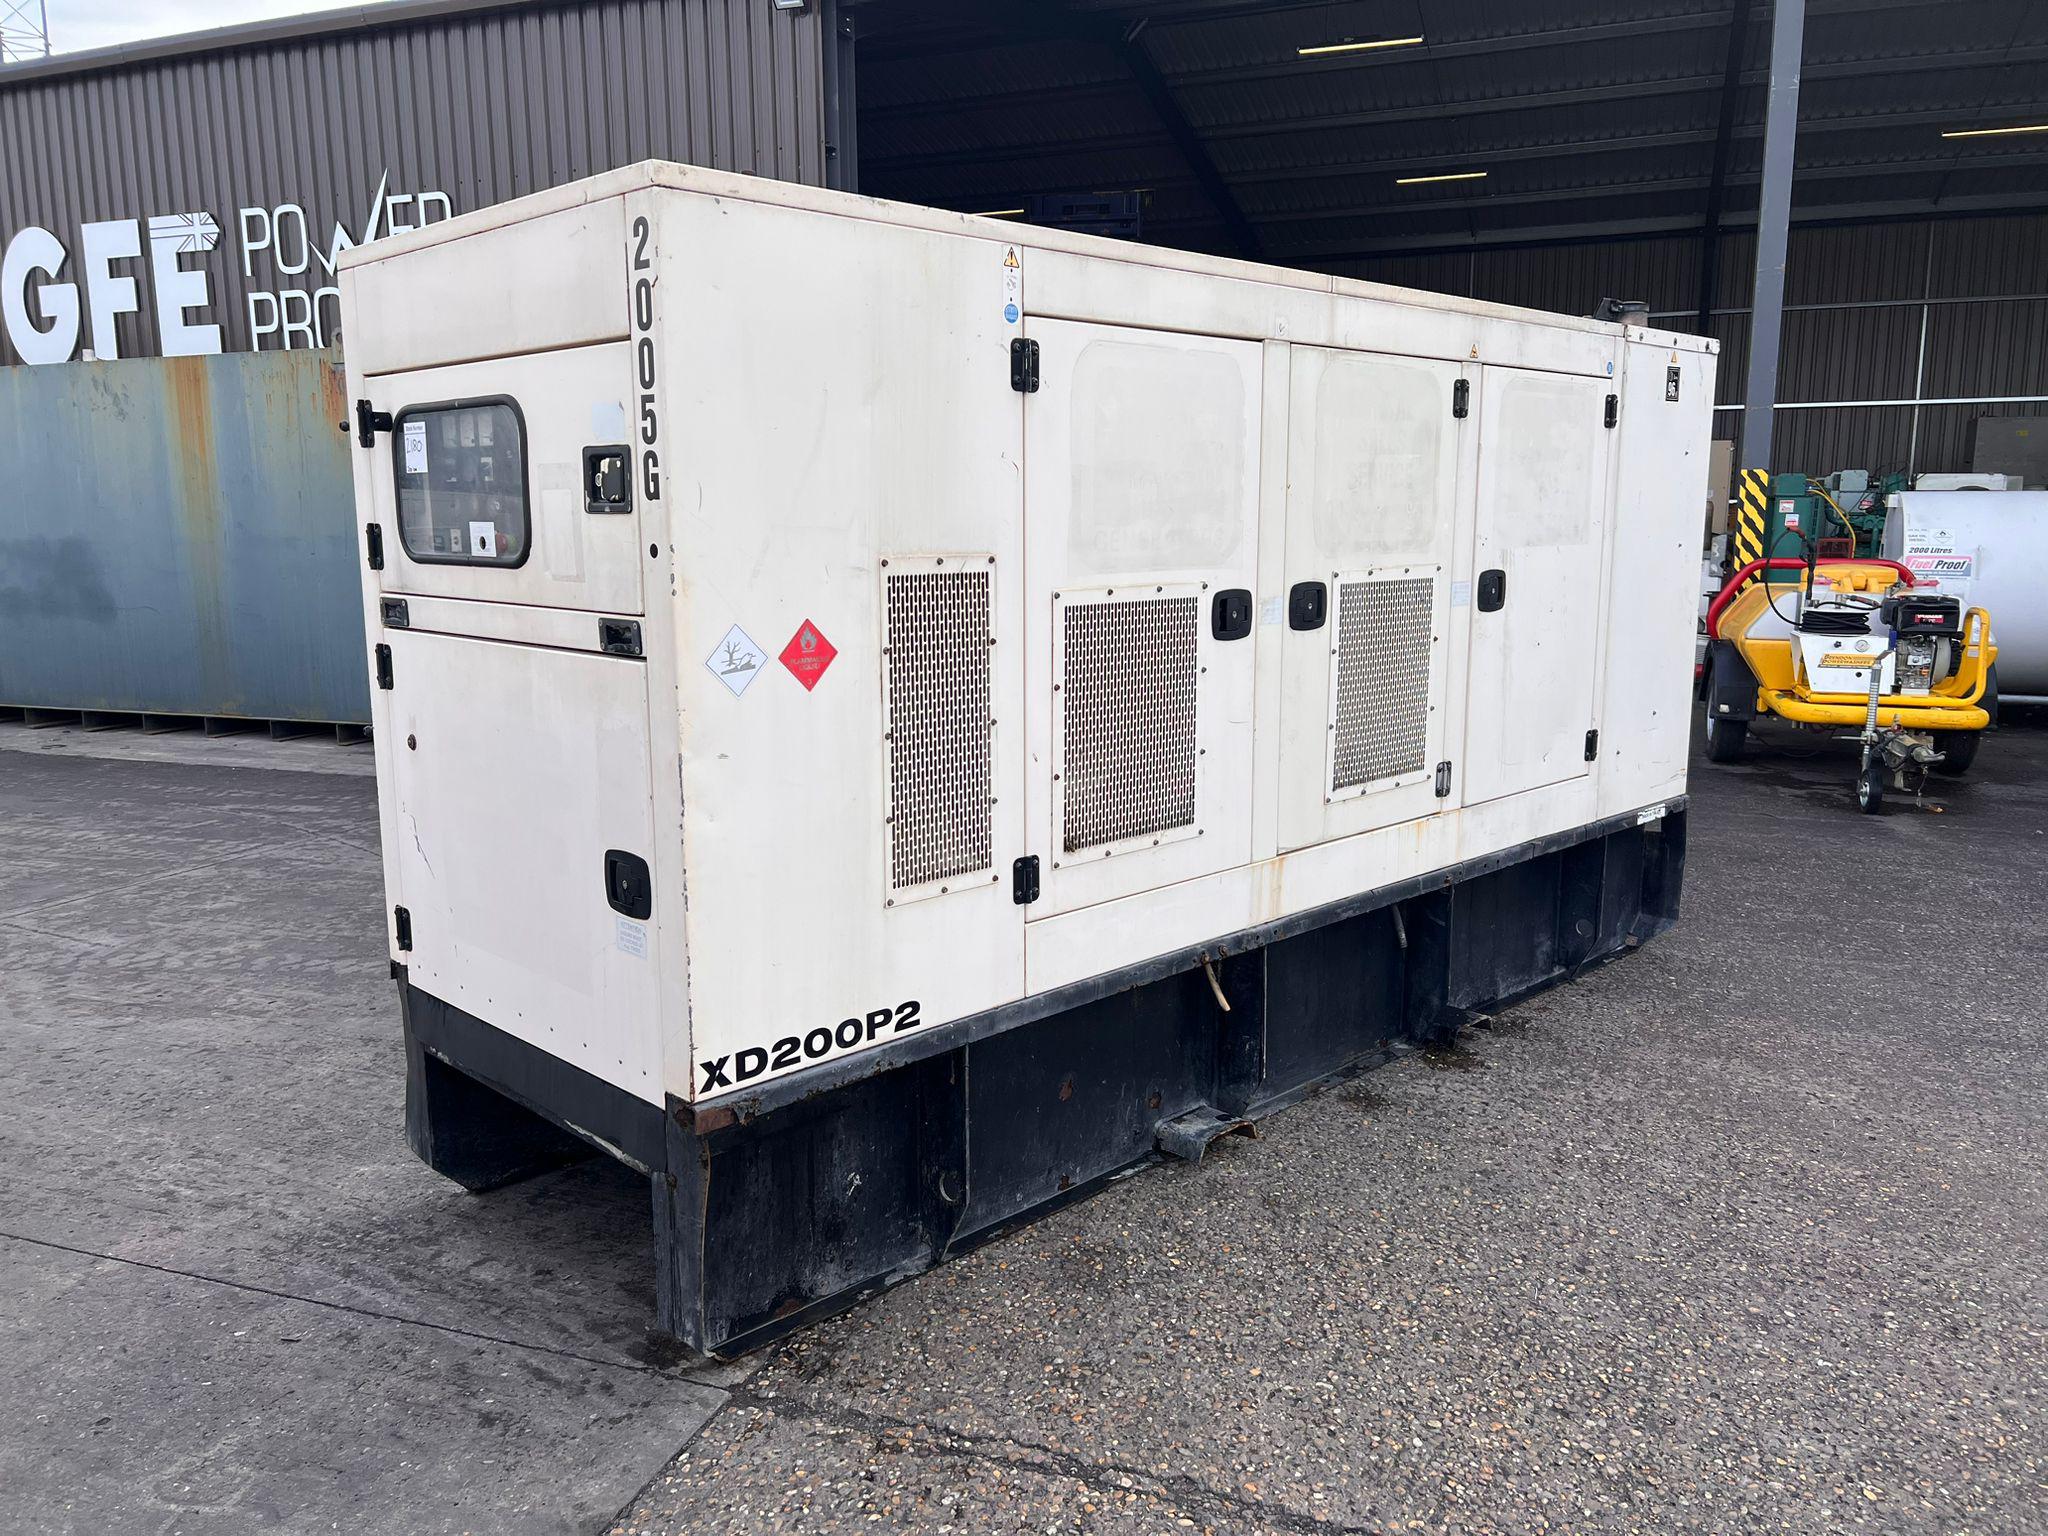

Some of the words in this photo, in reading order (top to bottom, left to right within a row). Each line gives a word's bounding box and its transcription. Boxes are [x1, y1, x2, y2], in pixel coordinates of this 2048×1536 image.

[1, 211, 223, 366] GFE
[632, 215, 661, 501] 2005G
[1909, 560, 1935, 569] Fuel
[1935, 560, 1967, 570] Proof
[698, 1000, 921, 1095] XD200P2
